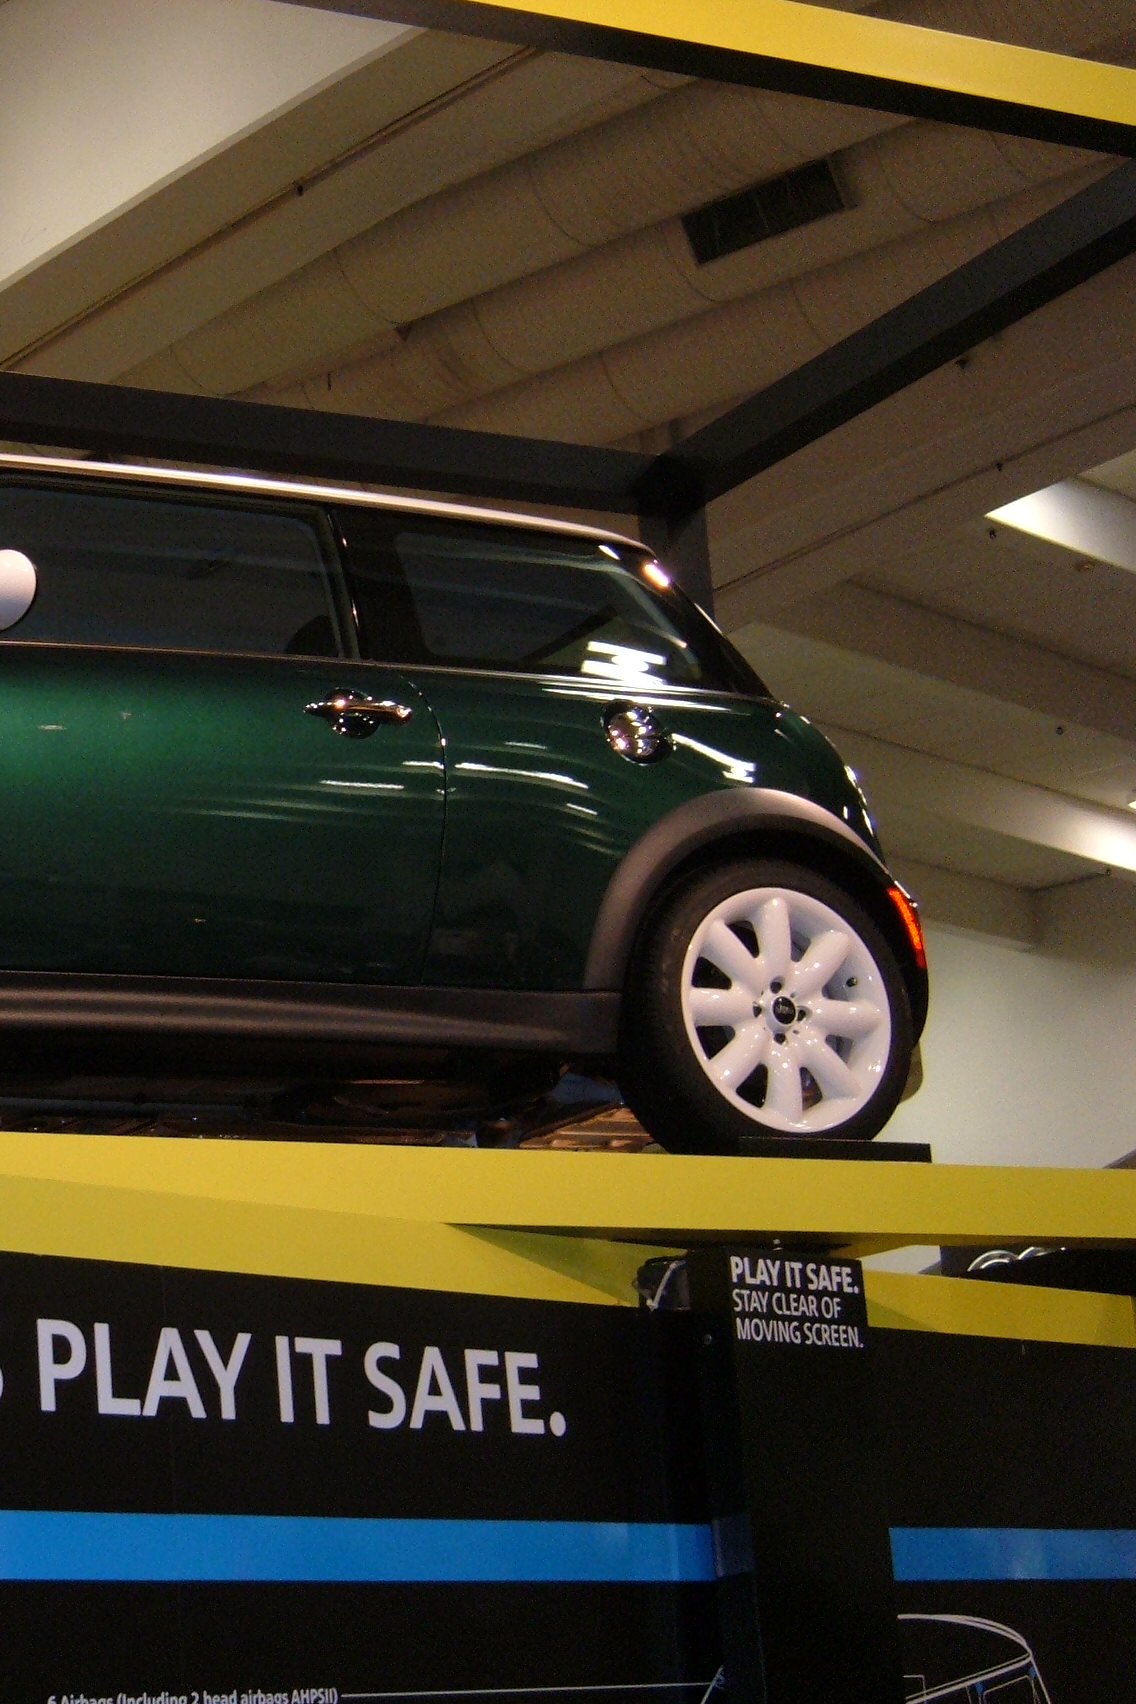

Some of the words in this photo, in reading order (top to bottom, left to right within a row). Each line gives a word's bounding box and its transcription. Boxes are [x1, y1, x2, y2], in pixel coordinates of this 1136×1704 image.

[730, 1256, 780, 1286] PLAY
[785, 1261, 803, 1288] IT
[806, 1263, 859, 1294] SAFE.
[732, 1289, 769, 1312] STAY
[772, 1292, 818, 1317] CLEAR
[821, 1296, 841, 1318] OF
[736, 1317, 801, 1344] MOVING
[804, 1322, 864, 1348] SCREEN.
[37, 1319, 251, 1420] PLAY
[275, 1336, 342, 1424] IT
[364, 1342, 566, 1437] SAFE.
